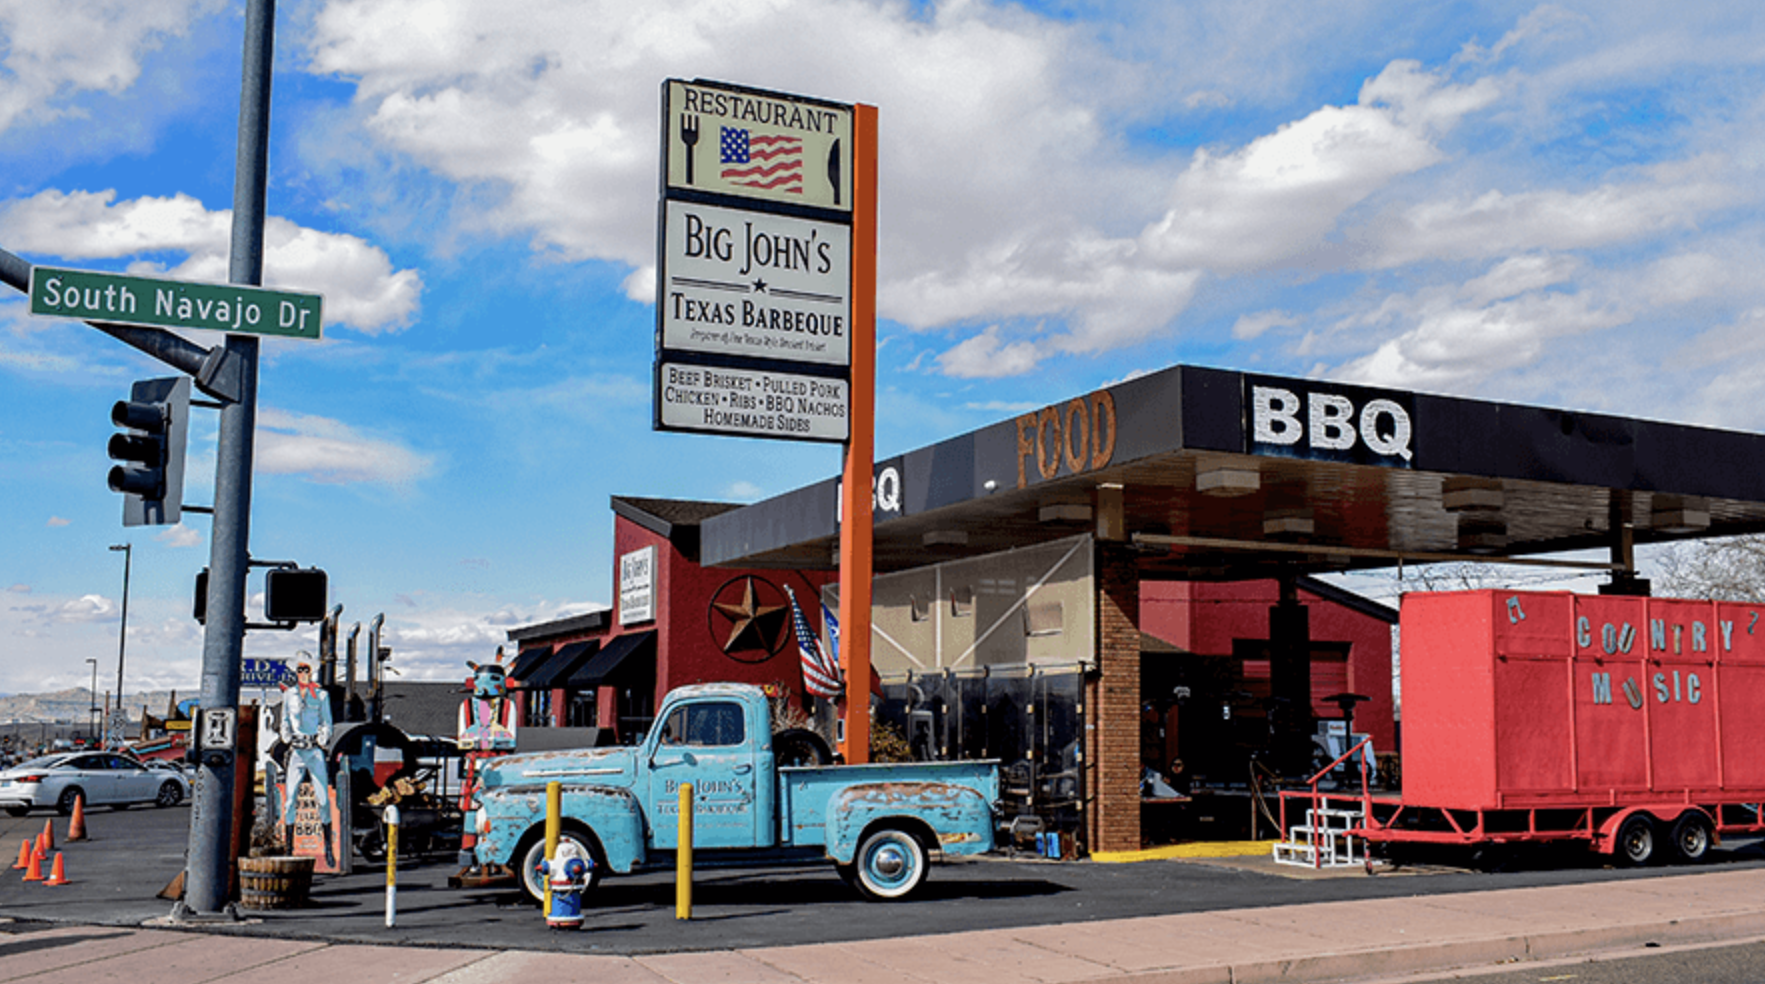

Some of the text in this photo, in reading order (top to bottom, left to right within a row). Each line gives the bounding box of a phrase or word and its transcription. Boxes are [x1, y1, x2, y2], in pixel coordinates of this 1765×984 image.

[684, 88, 838, 134] RESTAURANT
[684, 213, 831, 275] BIG JOHN'S
[43, 278, 311, 330] South Navajo Dr
[671, 292, 735, 325] TEXAS
[741, 299, 843, 337] BARBEQUE
[664, 386, 845, 417] CHICKEN RIBS BBQ NACHOS
[669, 367, 841, 399] BEEF BRISKET PULLED PORK
[704, 408, 811, 433] HOMEMADE SIDES
[1015, 389, 1117, 490] FOOD
[1252, 385, 1413, 461] BBQ
[1577, 616, 1733, 654] COUNTRY
[1592, 670, 1701, 709] MUSIC
[695, 778, 743, 796] JOHN'S
